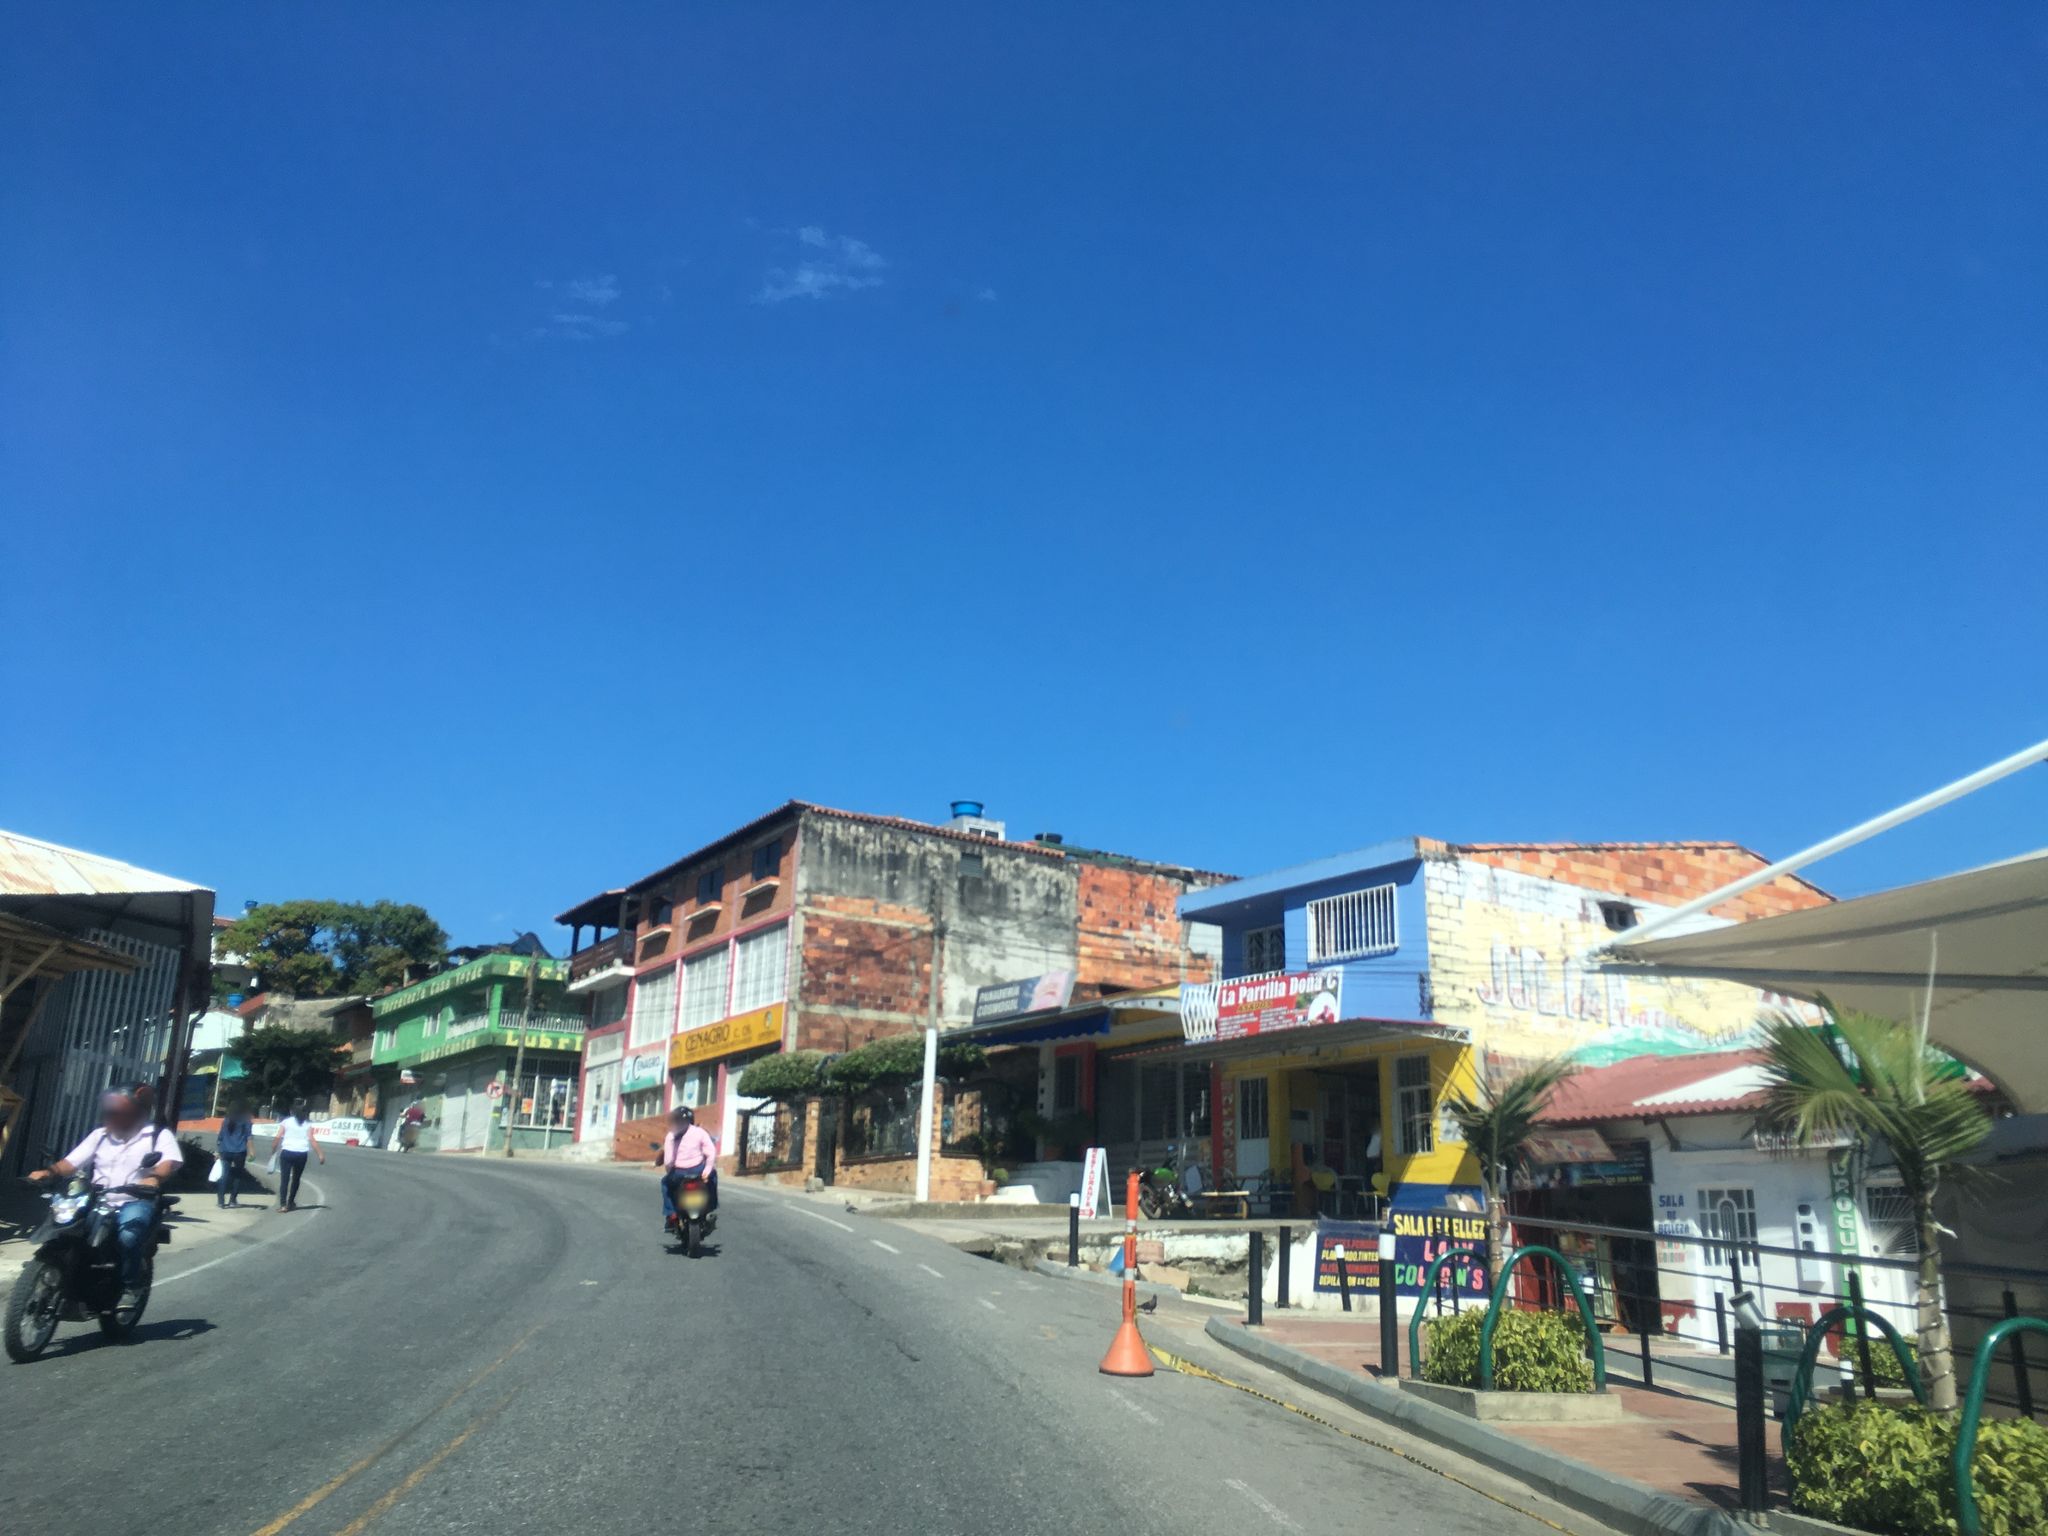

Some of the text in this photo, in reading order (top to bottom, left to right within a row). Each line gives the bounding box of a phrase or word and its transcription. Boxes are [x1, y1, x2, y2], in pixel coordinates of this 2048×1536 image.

[1221, 988, 1236, 1007] La
[1238, 979, 1287, 1004] Parrilla
[1289, 972, 1323, 996] Doña
[684, 1023, 731, 1052] CENAGRO
[1658, 1195, 1685, 1208] SALA
[1393, 1213, 1426, 1237] SALA
[1444, 1216, 1492, 1240] BELLEZ
